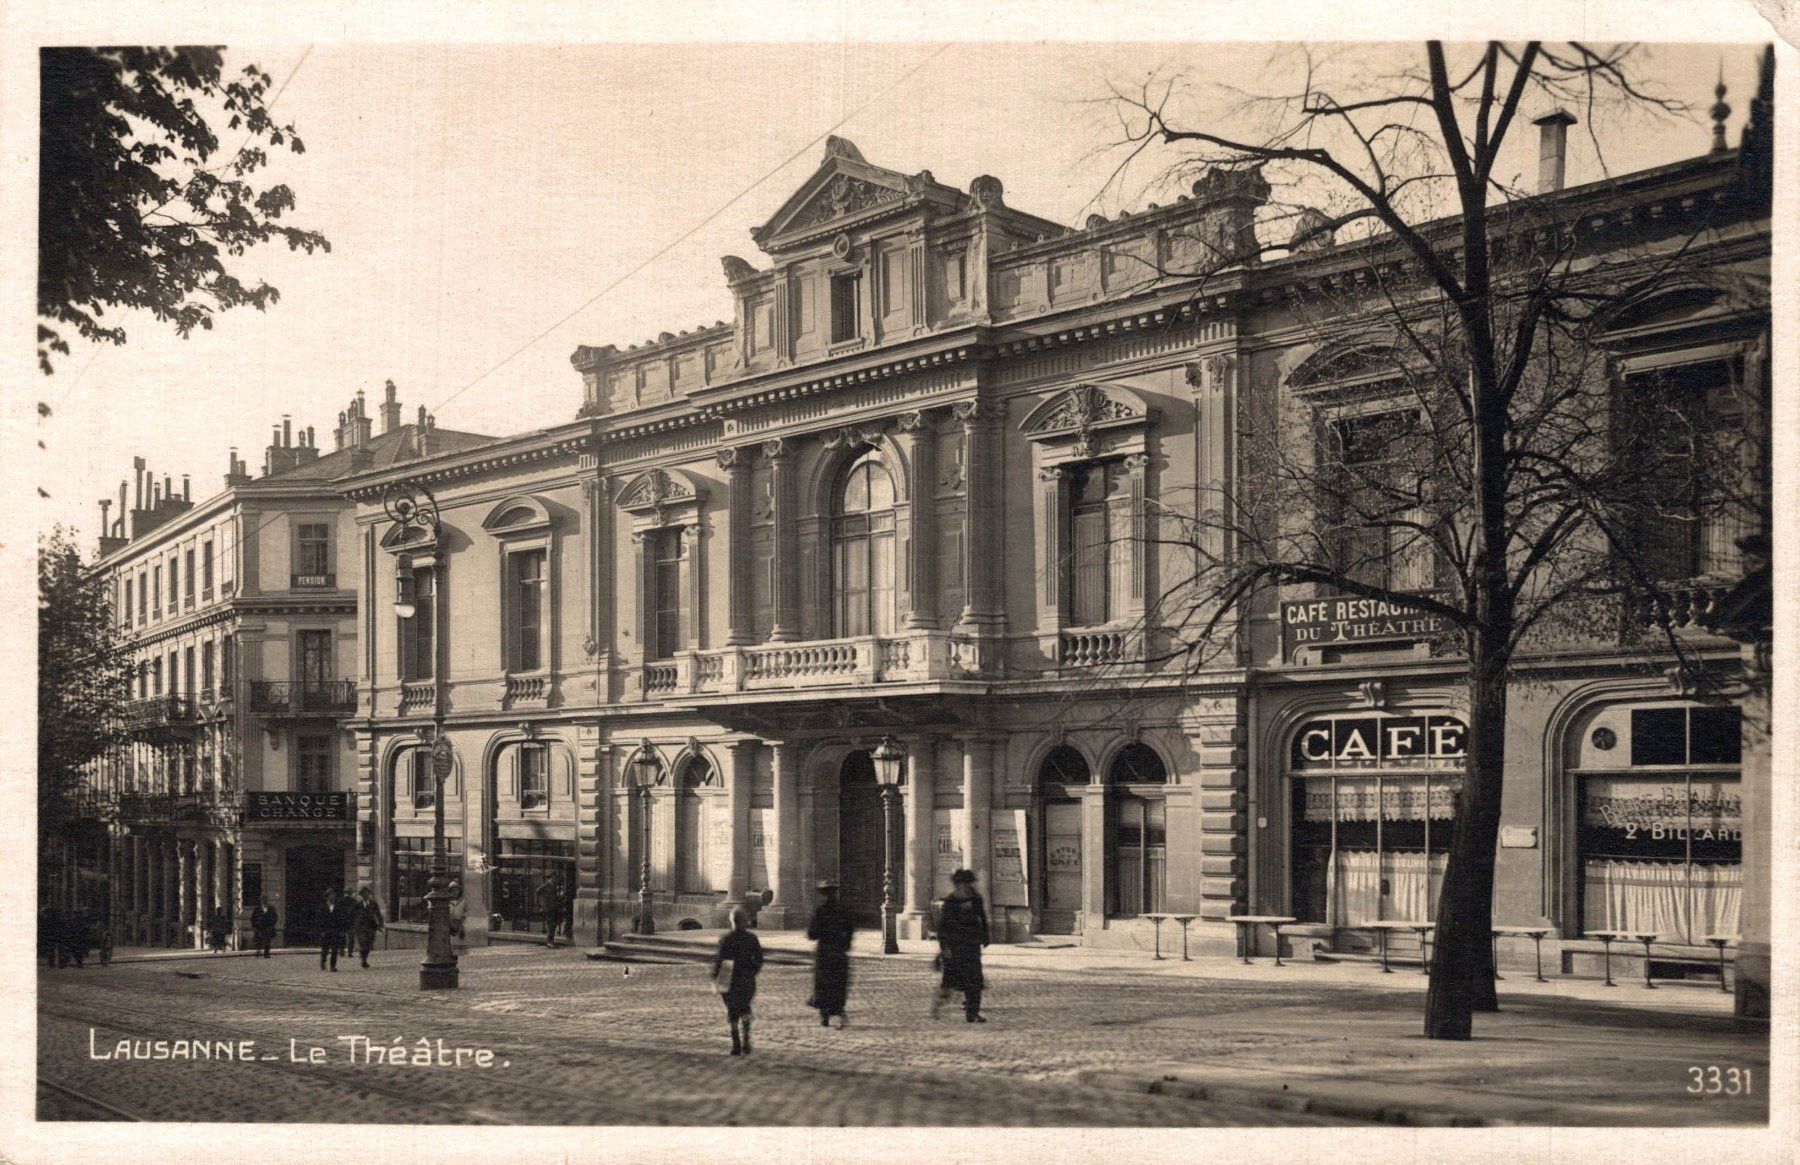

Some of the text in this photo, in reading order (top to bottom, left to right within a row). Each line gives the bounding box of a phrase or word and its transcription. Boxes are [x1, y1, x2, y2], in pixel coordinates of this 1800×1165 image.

[298, 576, 326, 585] PENSION
[1287, 600, 1428, 624] CAFÉ RESTAU
[1295, 627, 1321, 641] DU
[1300, 722, 1464, 761] CAFÉ
[259, 795, 340, 806] BANQUE
[260, 808, 336, 817] CHANGE
[1625, 822, 1638, 839] 2
